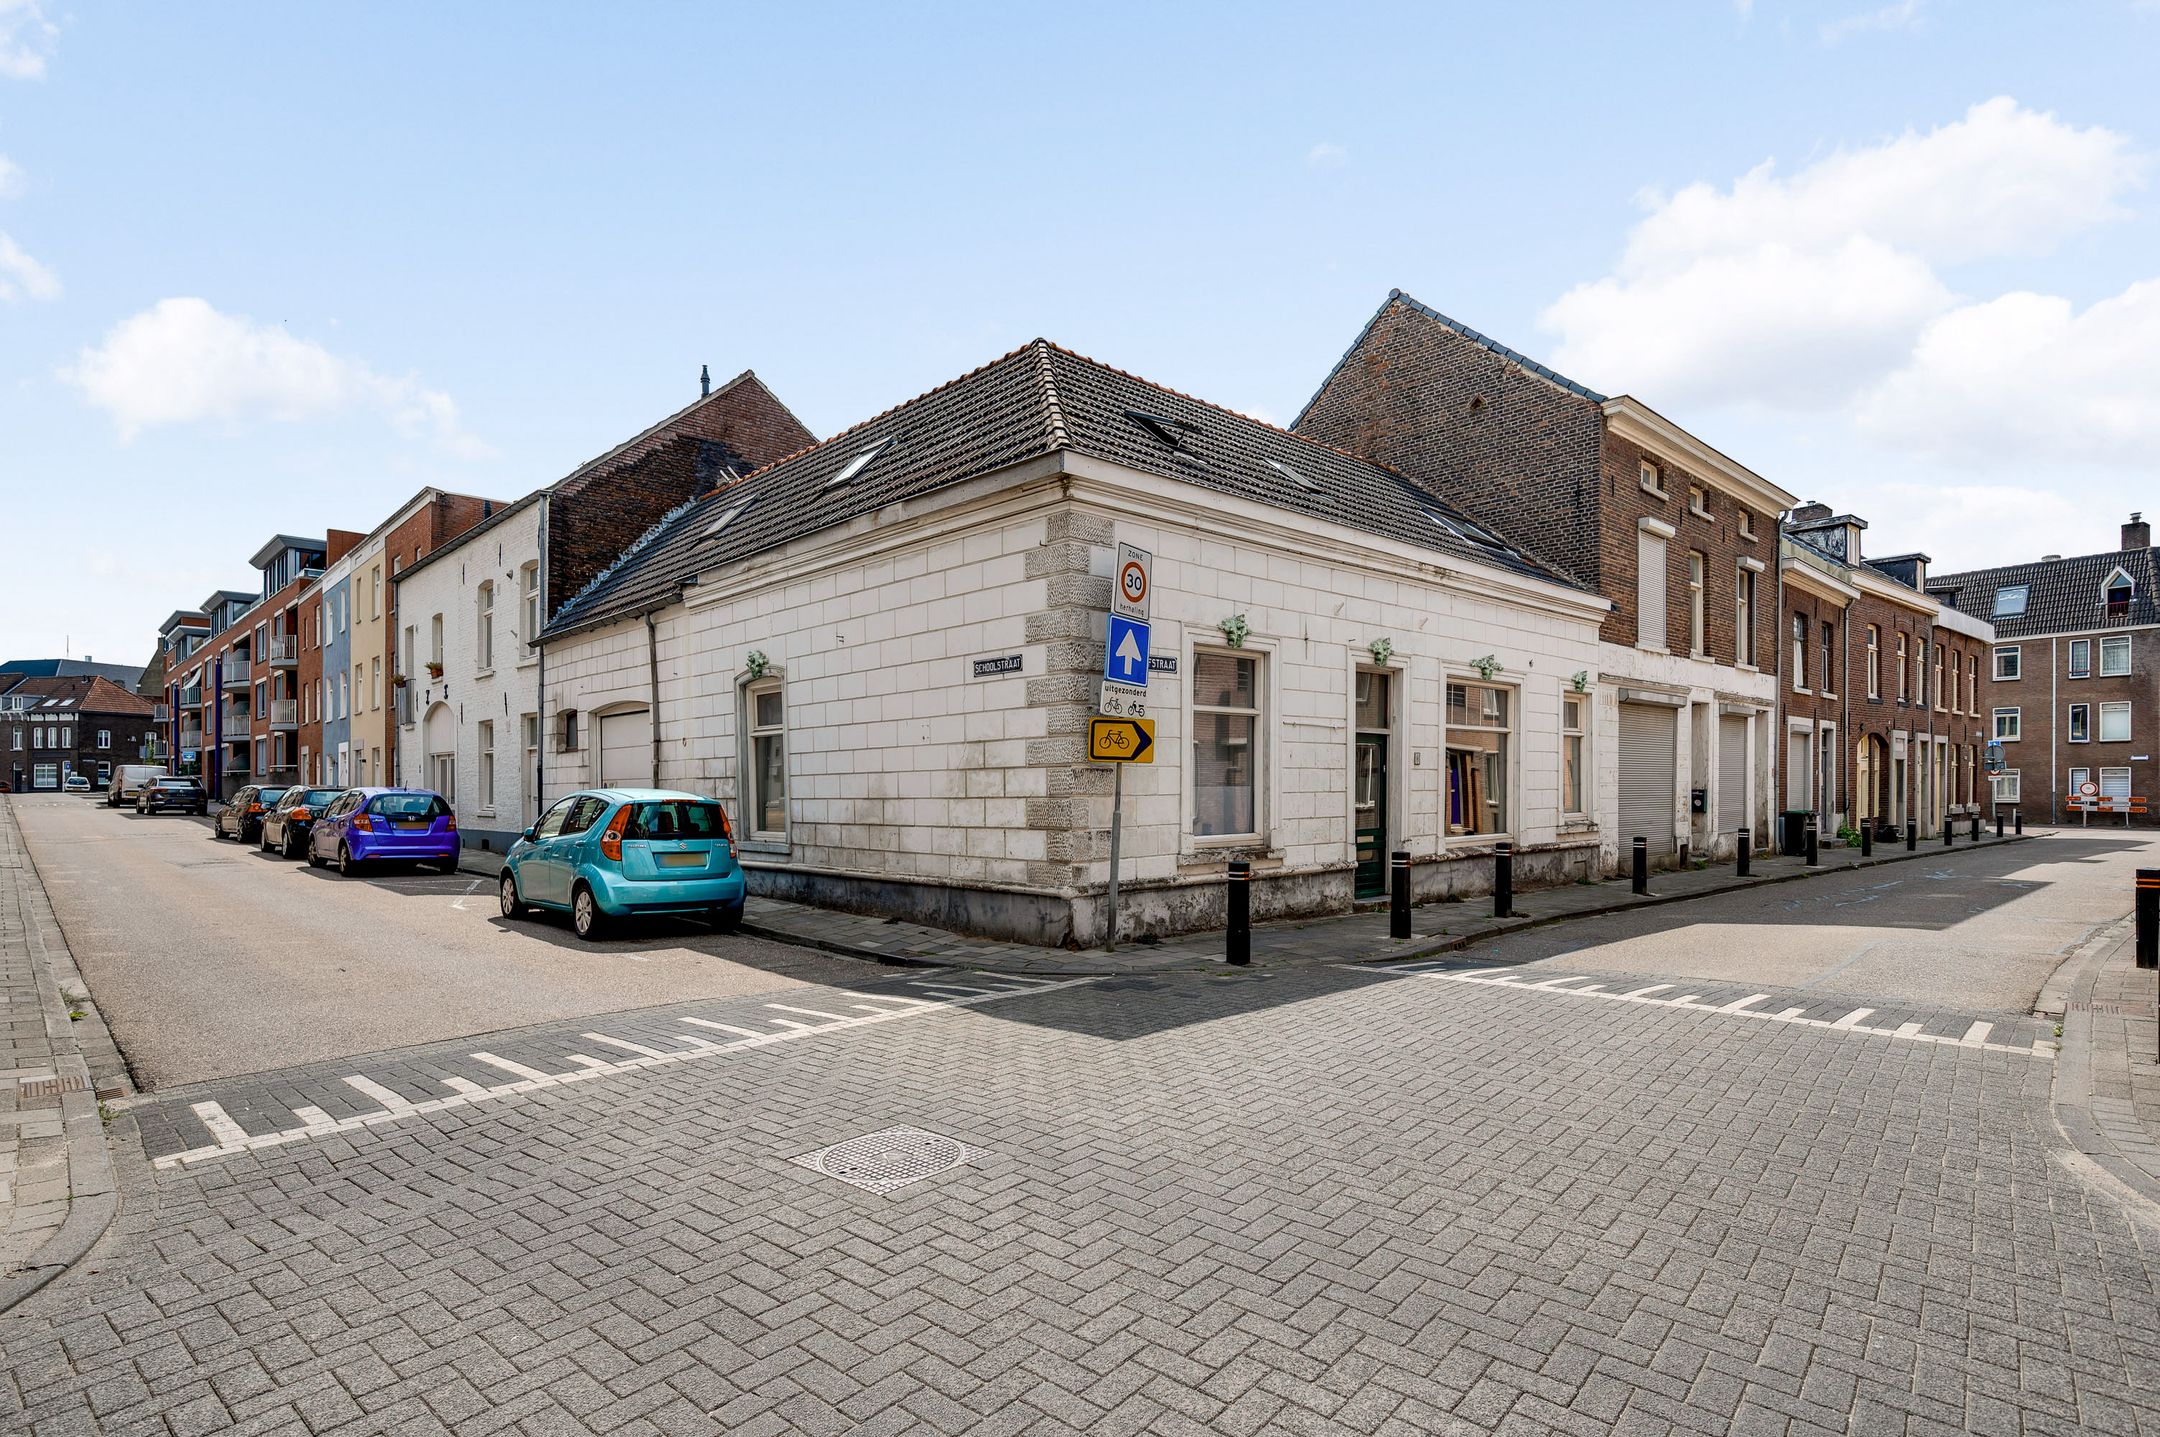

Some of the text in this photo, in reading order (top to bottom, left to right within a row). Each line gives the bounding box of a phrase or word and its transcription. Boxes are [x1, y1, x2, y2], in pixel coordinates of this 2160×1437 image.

[1128, 550, 1143, 561] ZONE
[1126, 573, 1142, 591] 30
[975, 659, 1020, 673] SCHOOLSTRAAT
[1104, 684, 1147, 697] uitgezonderd
